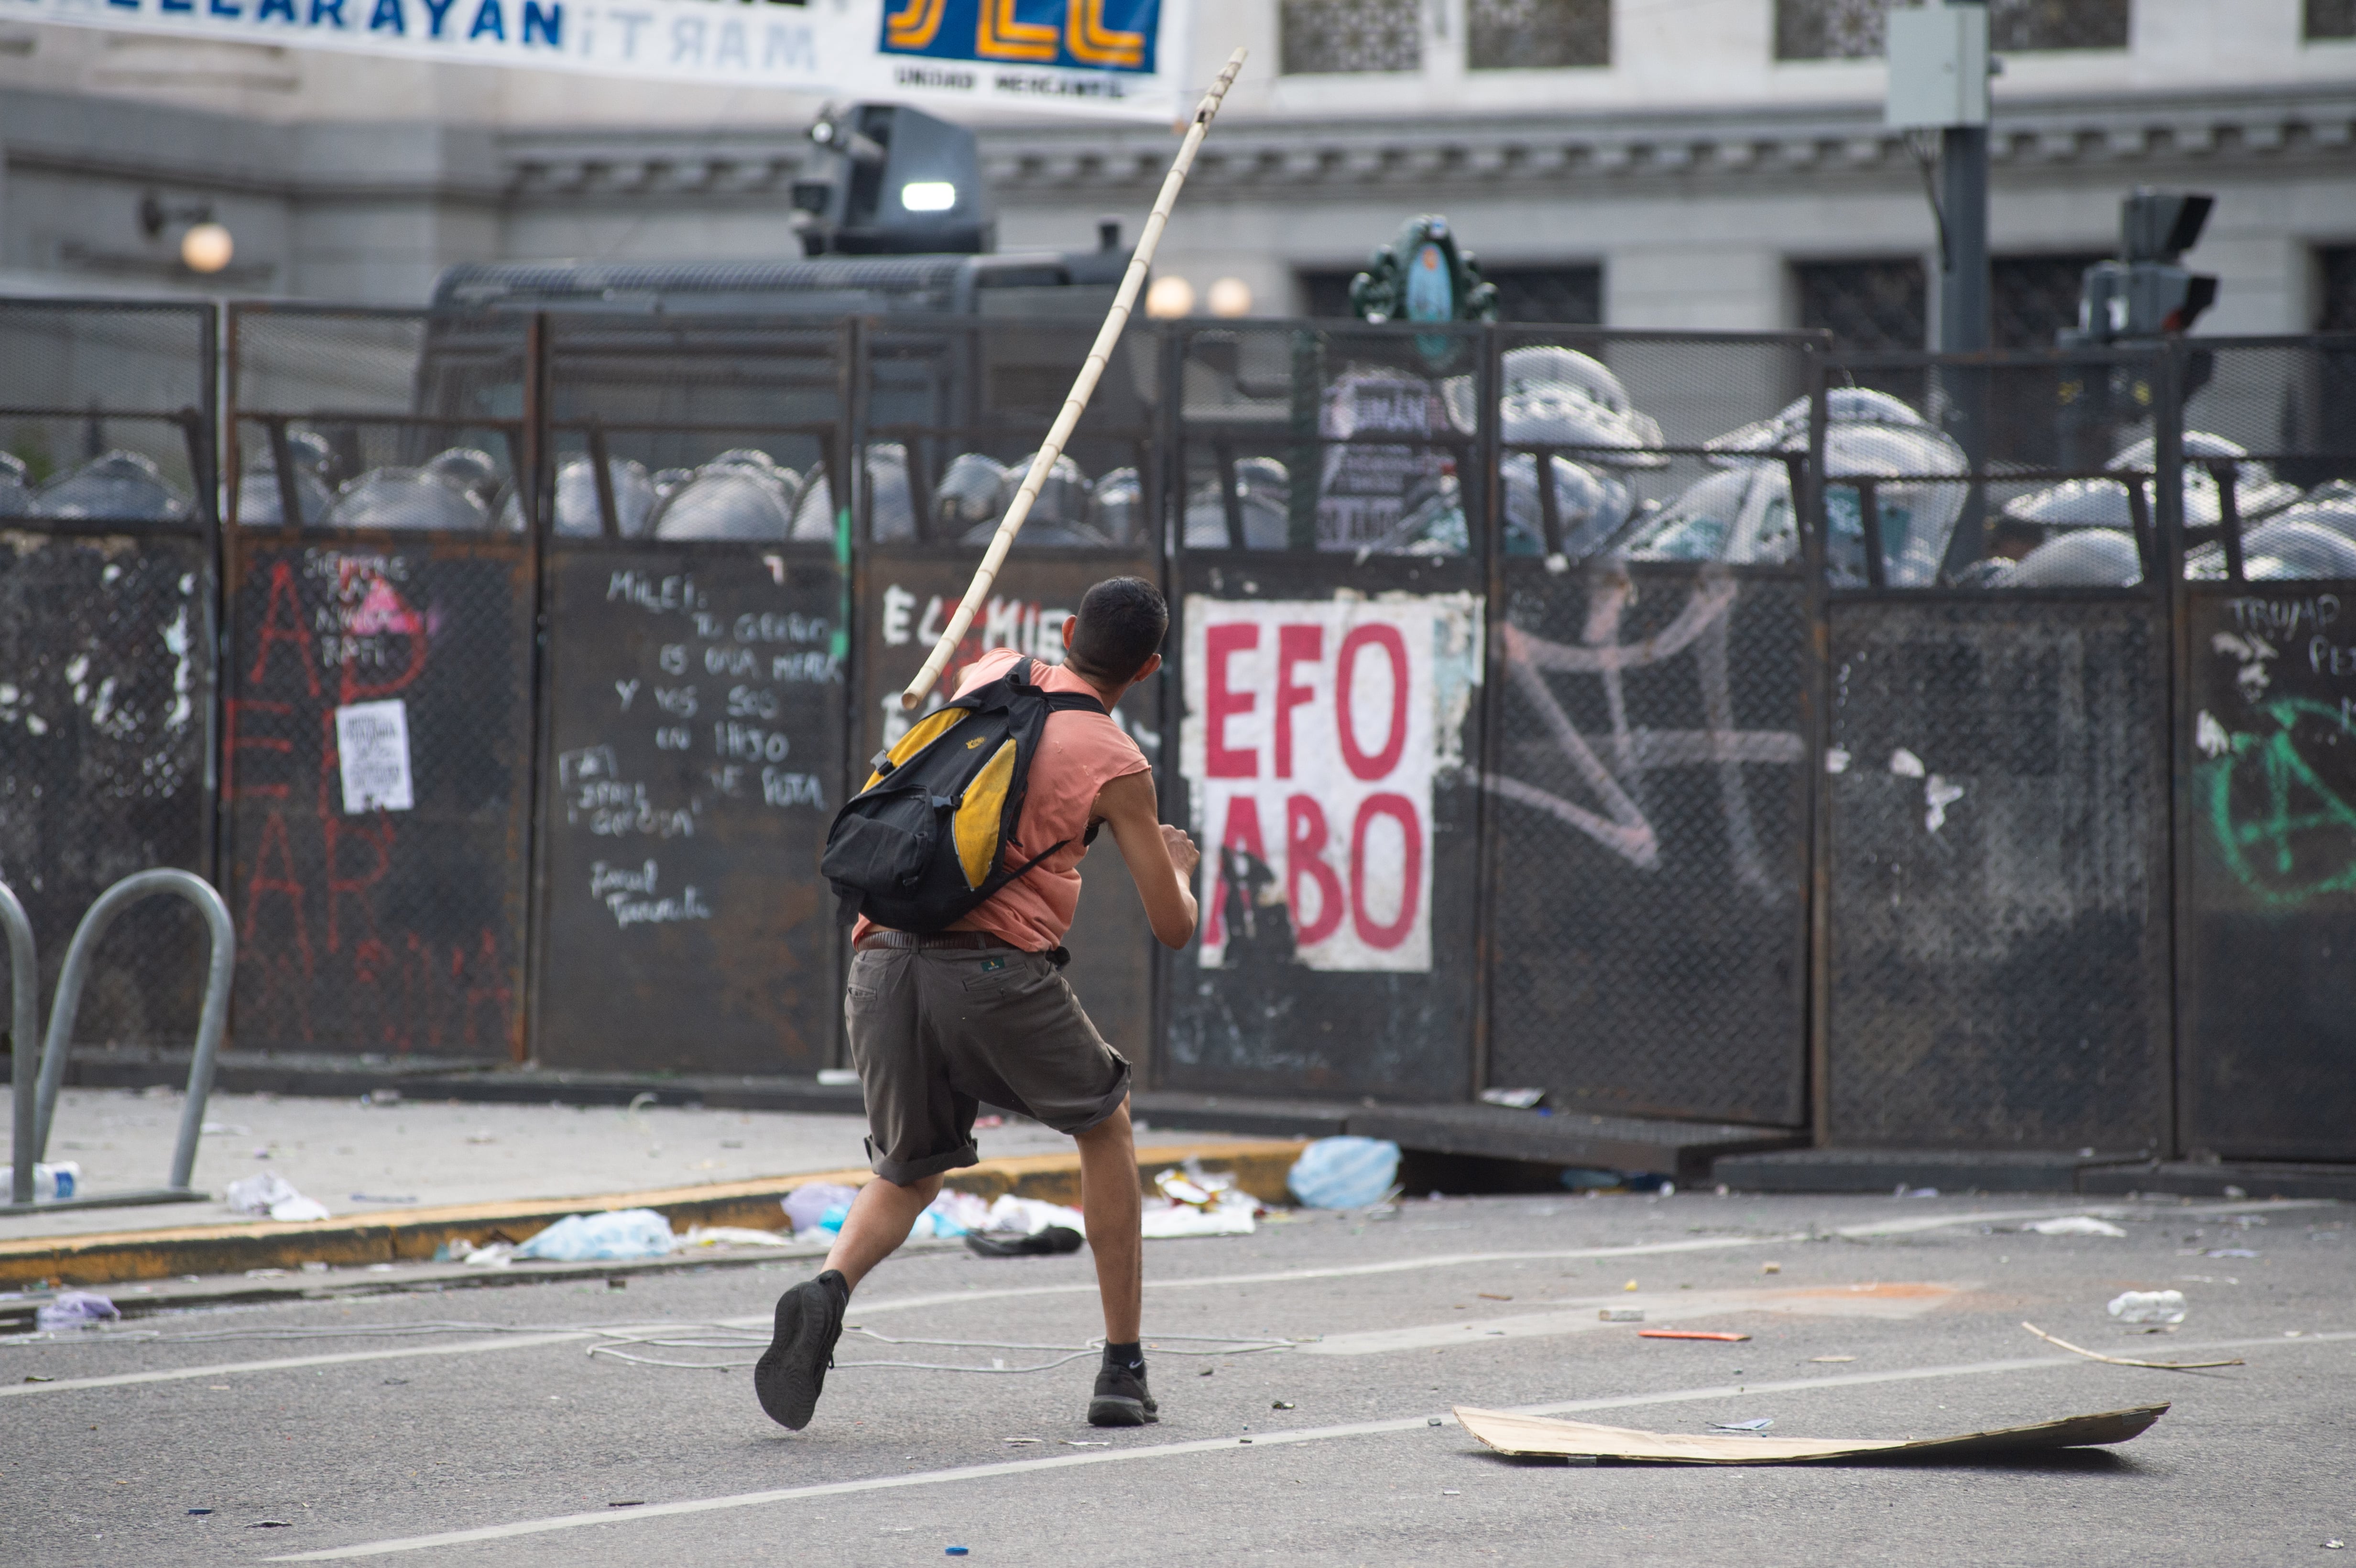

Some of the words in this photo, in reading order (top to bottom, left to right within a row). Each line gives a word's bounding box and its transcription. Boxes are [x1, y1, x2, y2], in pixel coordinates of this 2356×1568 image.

[2225, 593, 2341, 642] TRUMP
[615, 677, 641, 712] Y
[1205, 621, 1408, 781] EFO
[761, 765, 829, 812] PUTA
[1202, 792, 1423, 950] ABO
